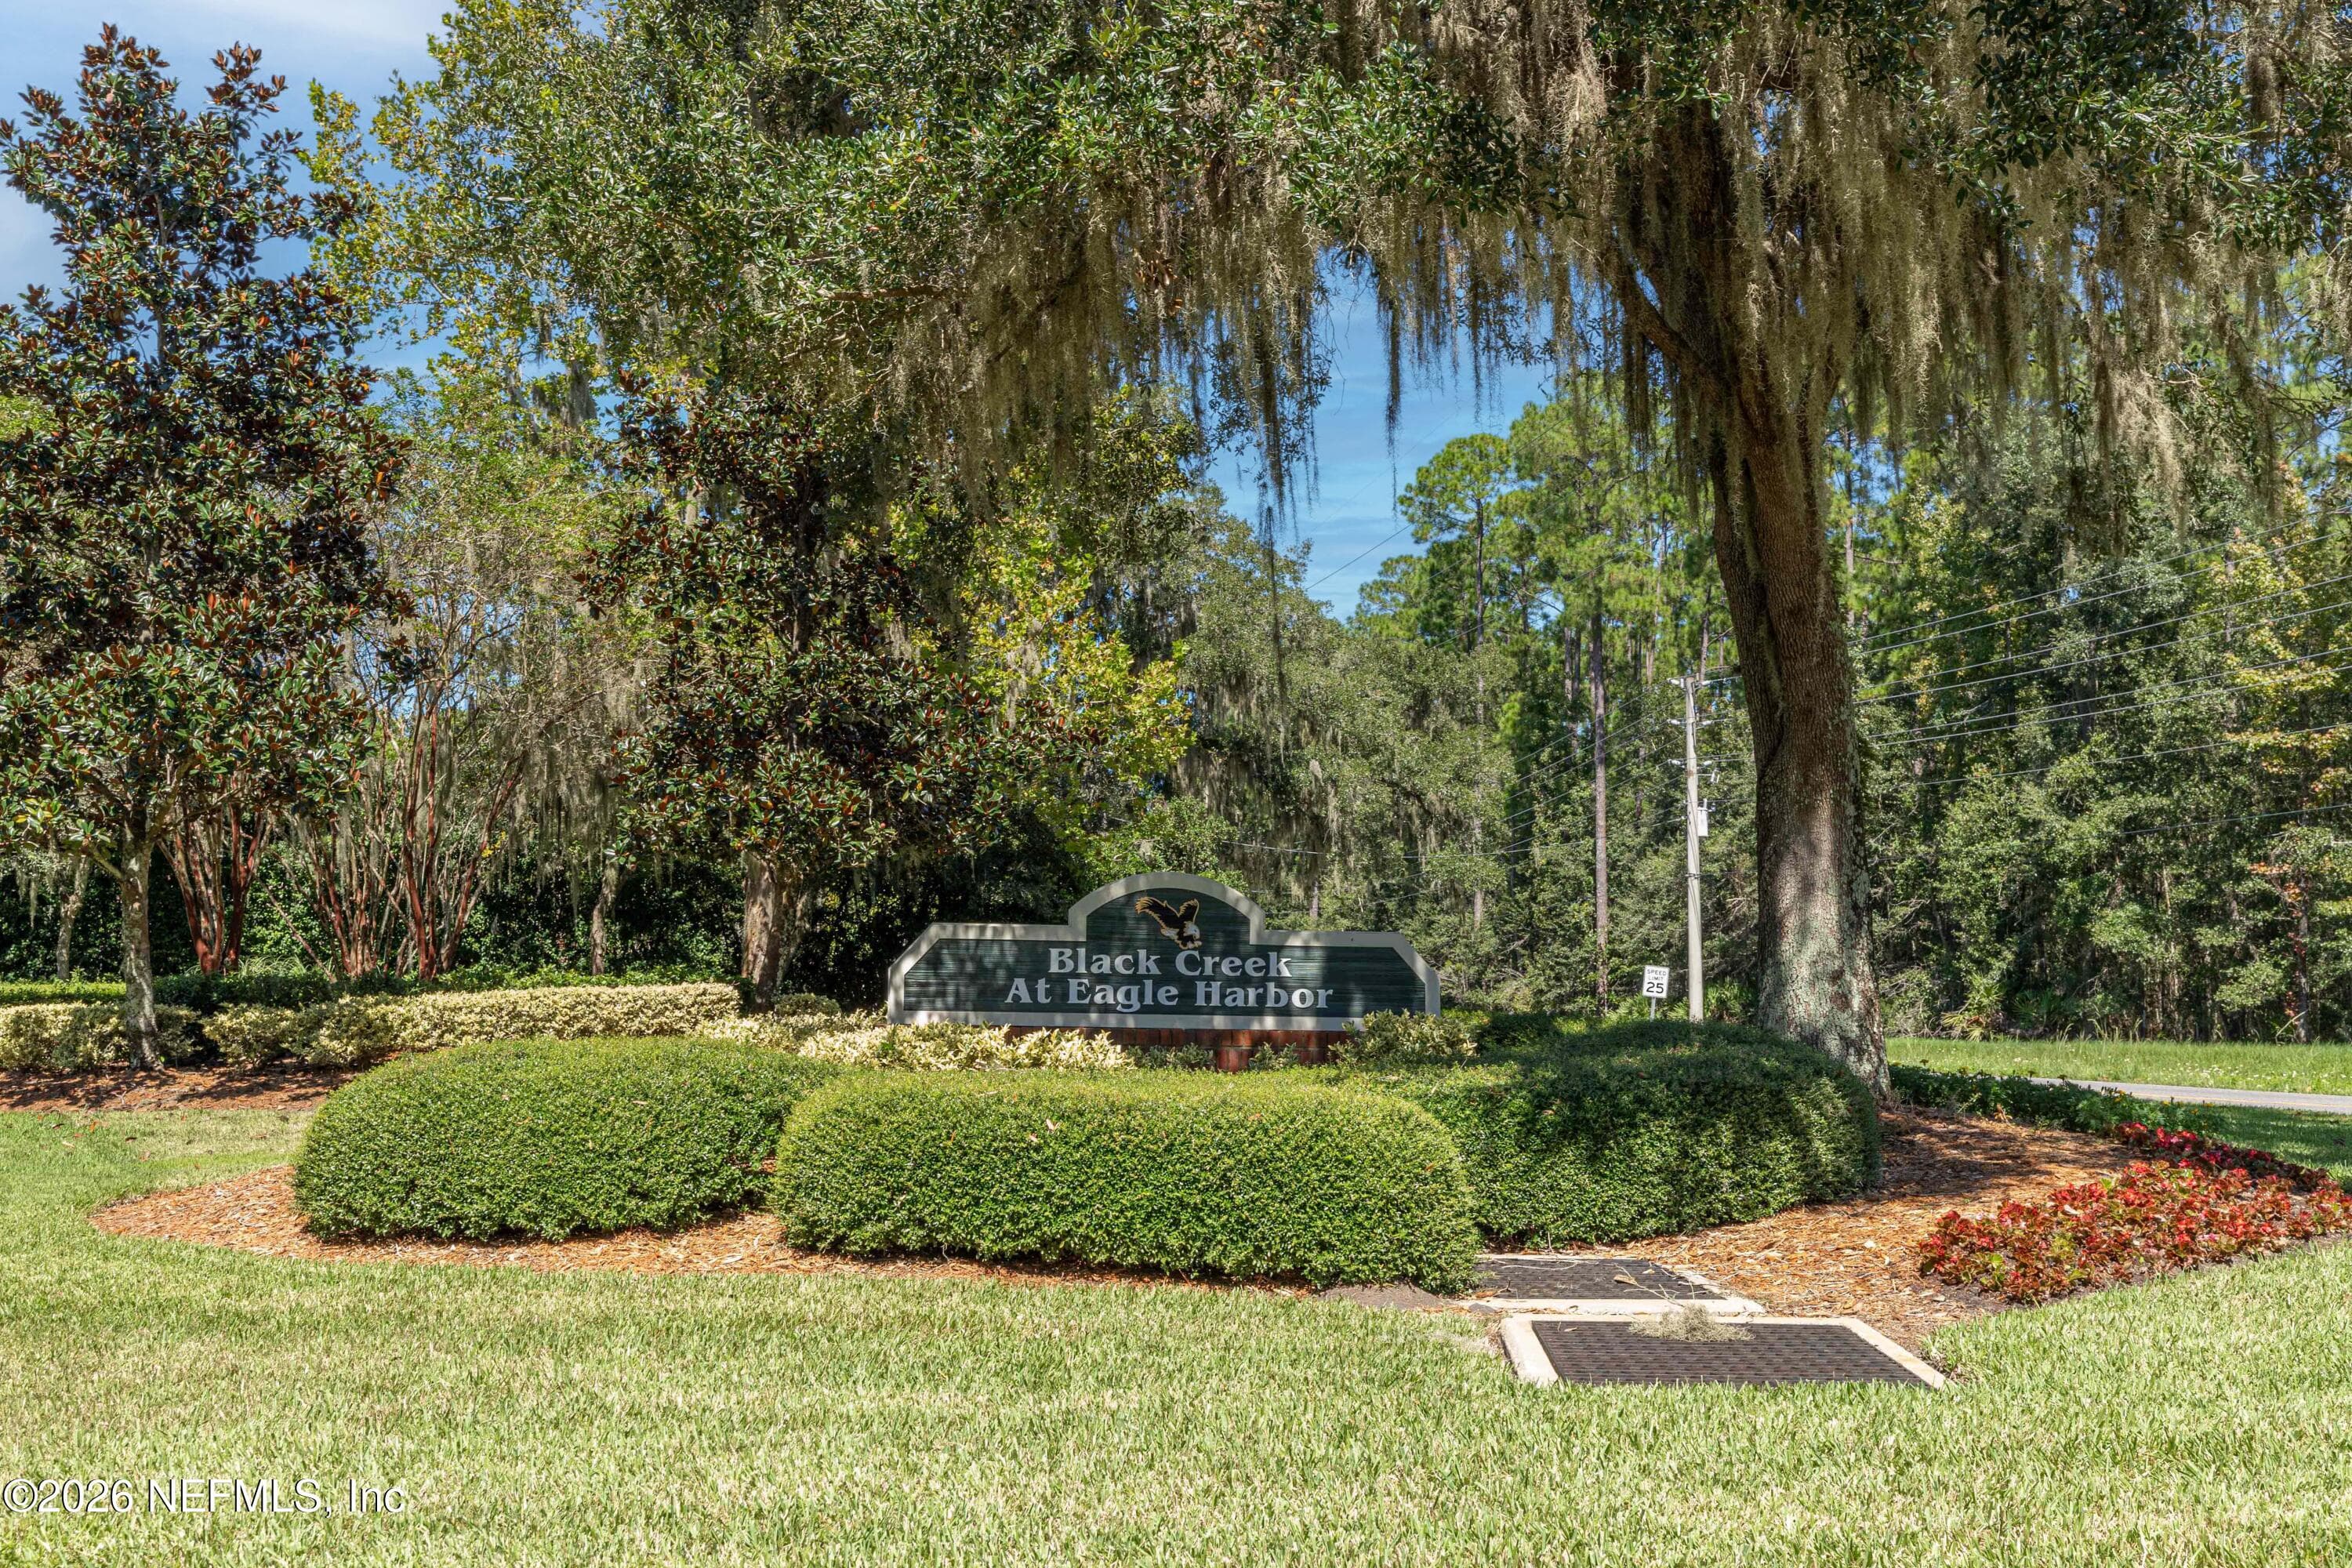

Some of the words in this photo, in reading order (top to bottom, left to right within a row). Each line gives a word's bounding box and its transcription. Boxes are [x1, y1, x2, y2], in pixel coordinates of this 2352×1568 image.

[1048, 948, 1162, 975] Black
[1175, 949, 1292, 978] Creek
[1004, 978, 1051, 1004] At
[1067, 978, 1179, 1012] Eagle
[1195, 981, 1334, 1009] Harbor
[1646, 982, 1664, 993] 25
